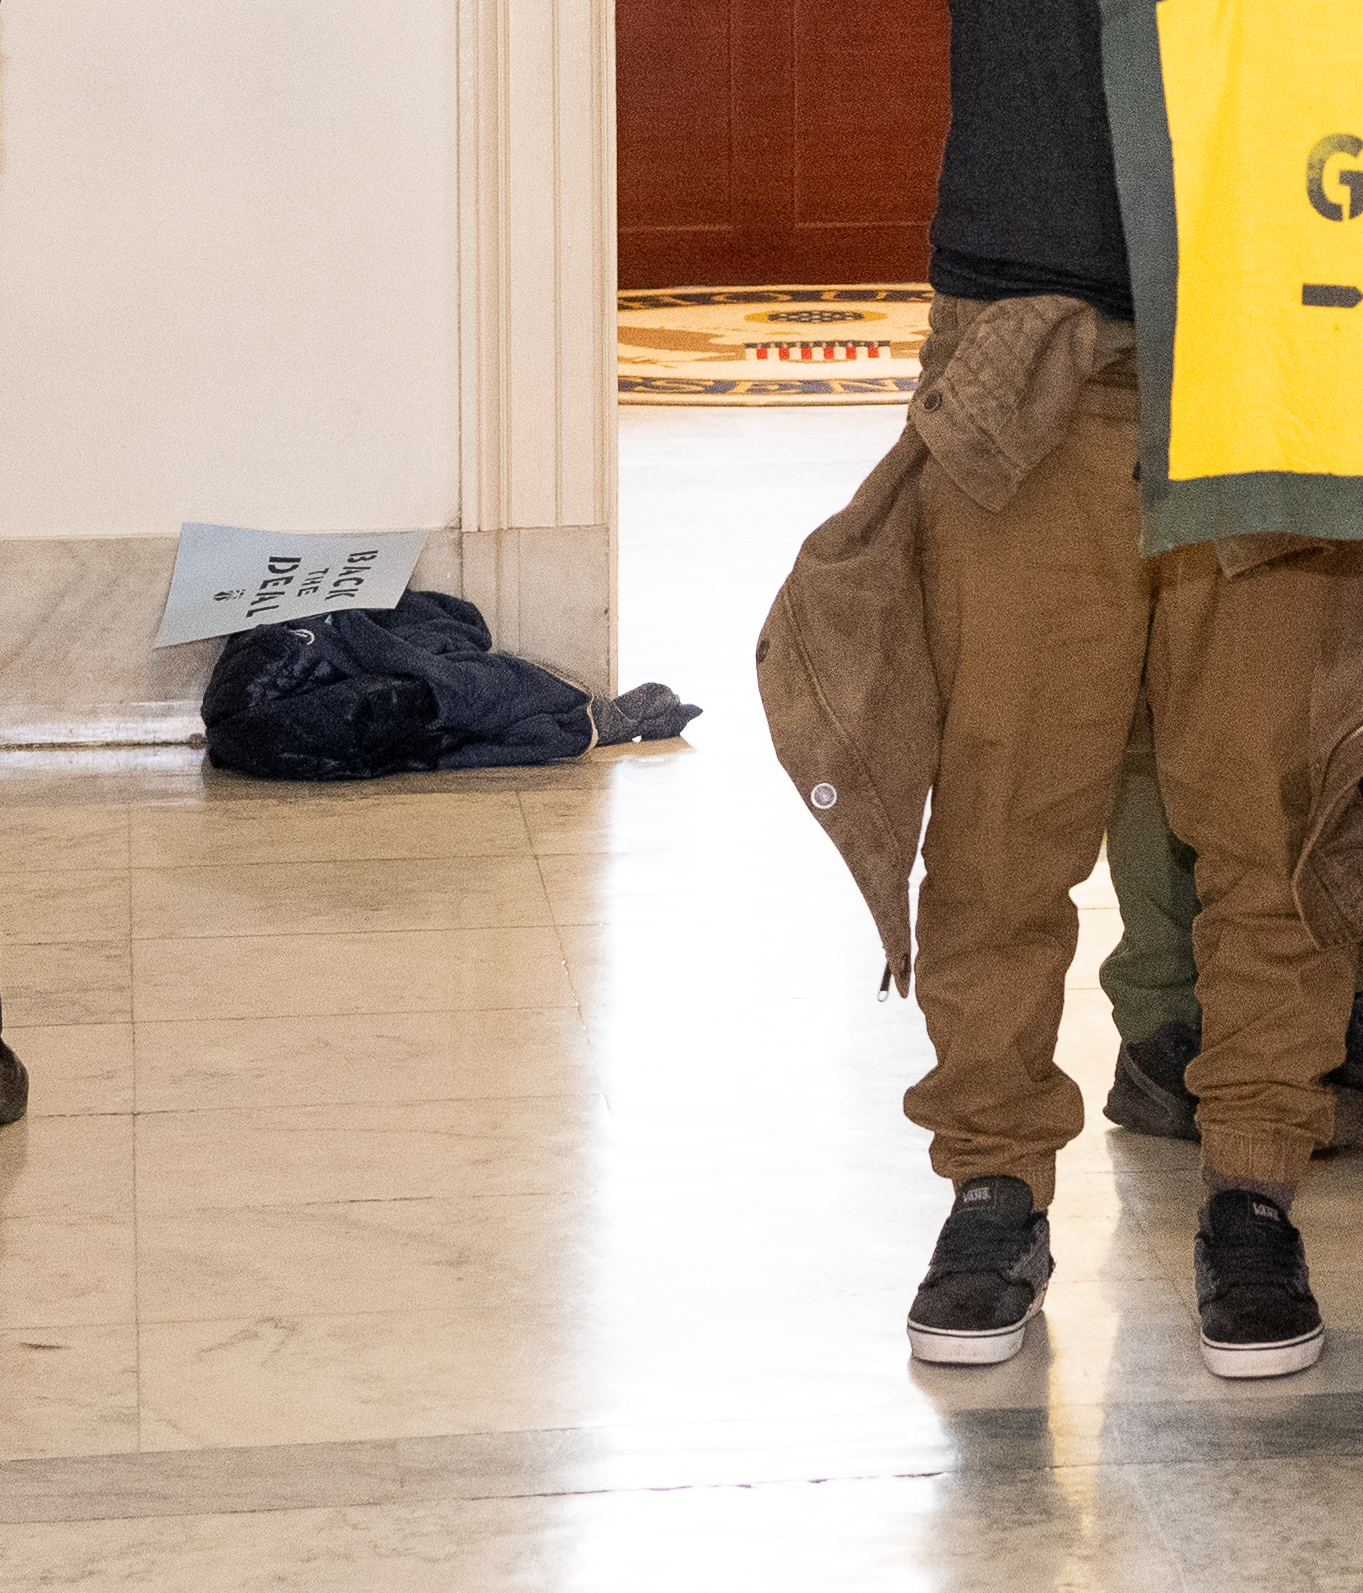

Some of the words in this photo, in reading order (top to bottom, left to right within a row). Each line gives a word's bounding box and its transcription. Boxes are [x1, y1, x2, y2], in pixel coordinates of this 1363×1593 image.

[245, 557, 301, 618] DEAL
[297, 568, 329, 597] THE
[325, 550, 378, 601] BACK
